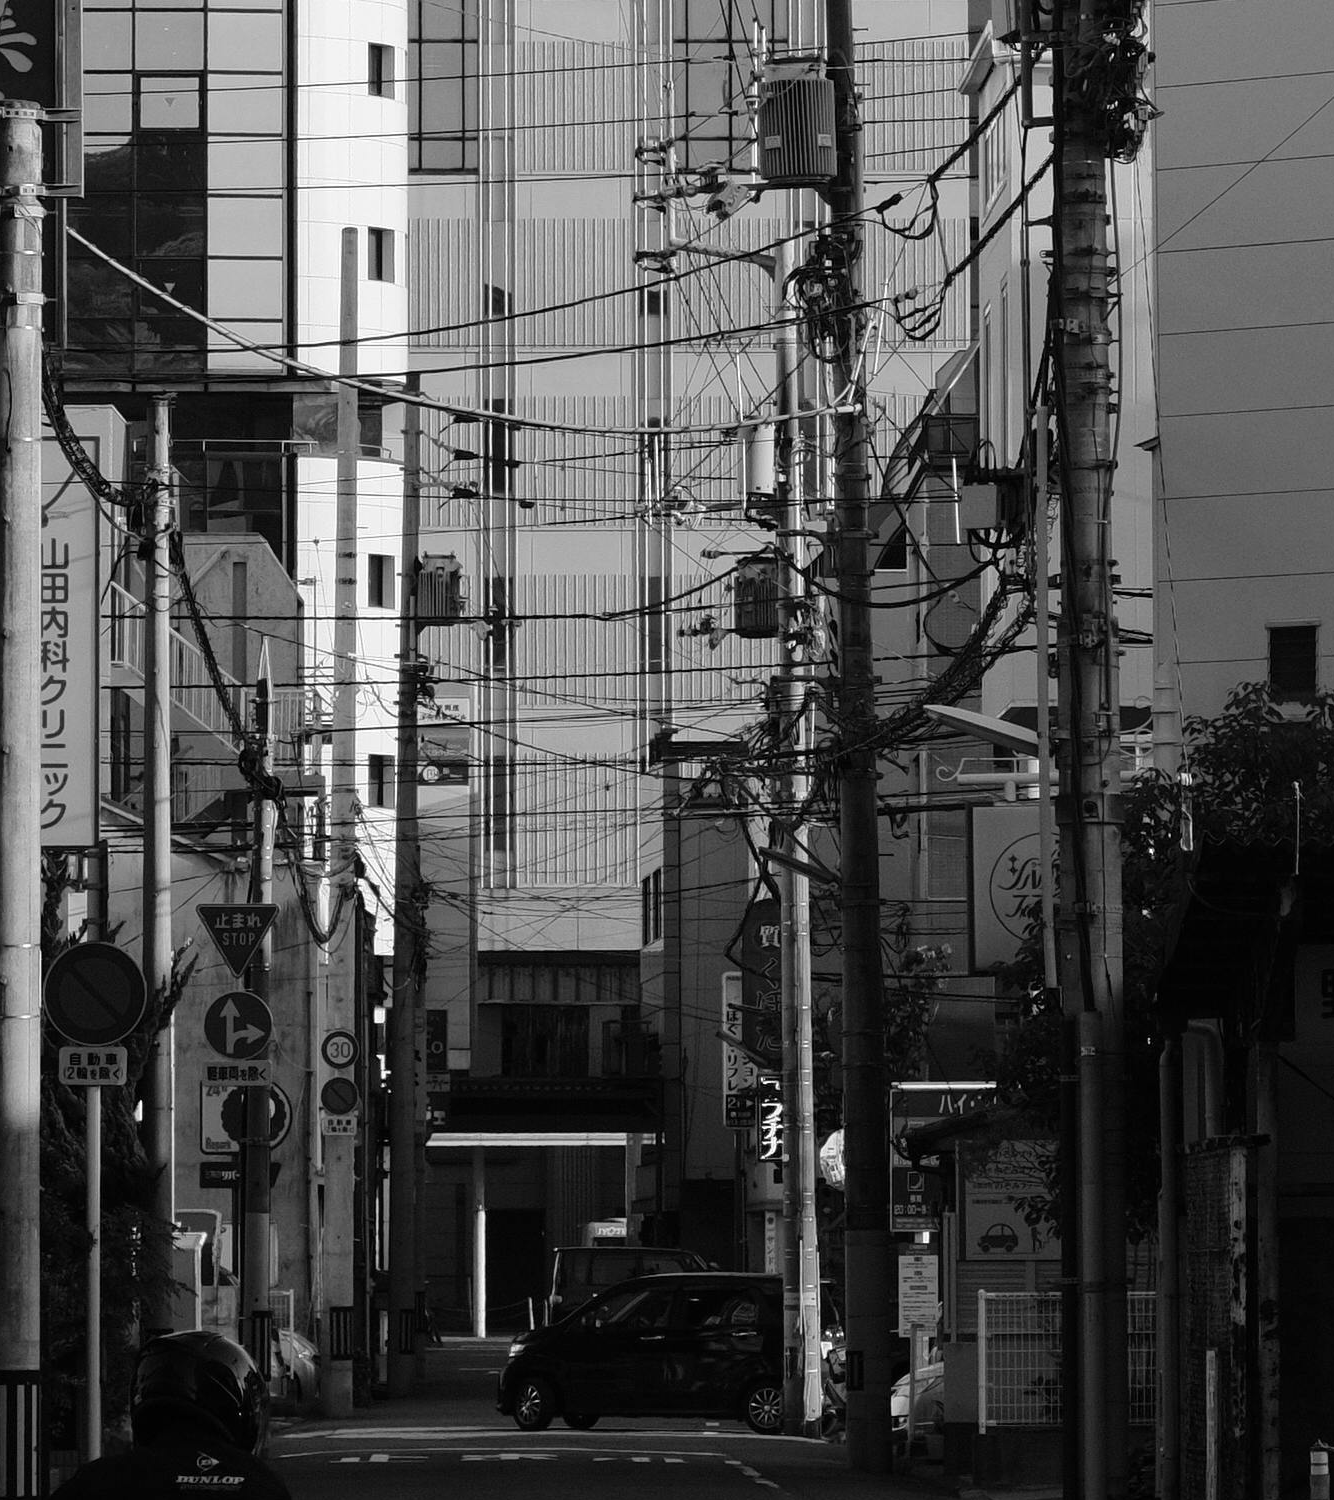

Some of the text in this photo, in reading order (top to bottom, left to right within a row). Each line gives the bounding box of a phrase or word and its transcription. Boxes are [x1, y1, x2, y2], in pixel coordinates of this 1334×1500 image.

[214, 912, 262, 929] 止まれ
[222, 932, 256, 946] STOP
[330, 1042, 350, 1059] 30
[69, 1052, 118, 1067] 自動車
[207, 1065, 266, 1081] 軽車両を除く
[176, 1475, 245, 1484] DUNLOP
